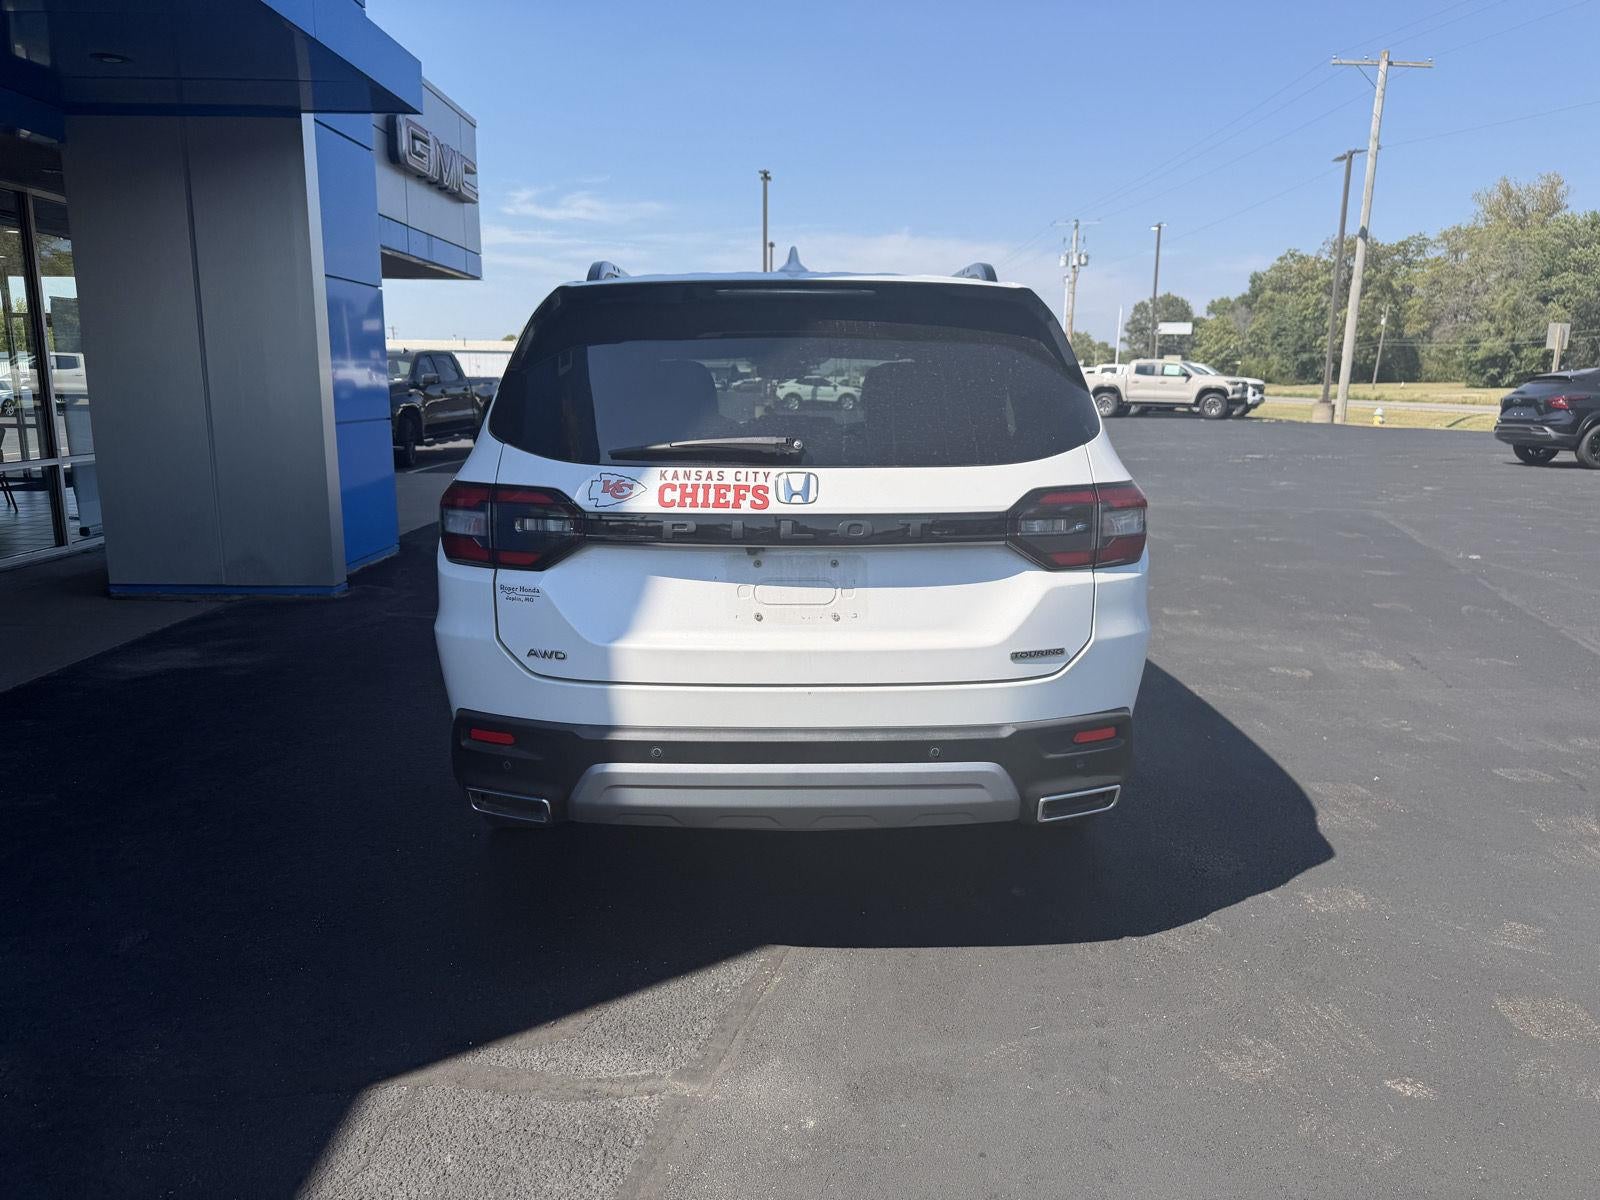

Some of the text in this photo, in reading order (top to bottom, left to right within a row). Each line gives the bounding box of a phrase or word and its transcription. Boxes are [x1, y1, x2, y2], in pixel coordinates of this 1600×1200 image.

[388, 114, 478, 203] GMC
[659, 470, 771, 483] KANSAS CITY
[601, 479, 634, 499] KC
[658, 483, 770, 510] CHIEFS
[662, 520, 931, 539] PILOT
[527, 648, 567, 660] AWD
[1011, 648, 1065, 659] TOURING
